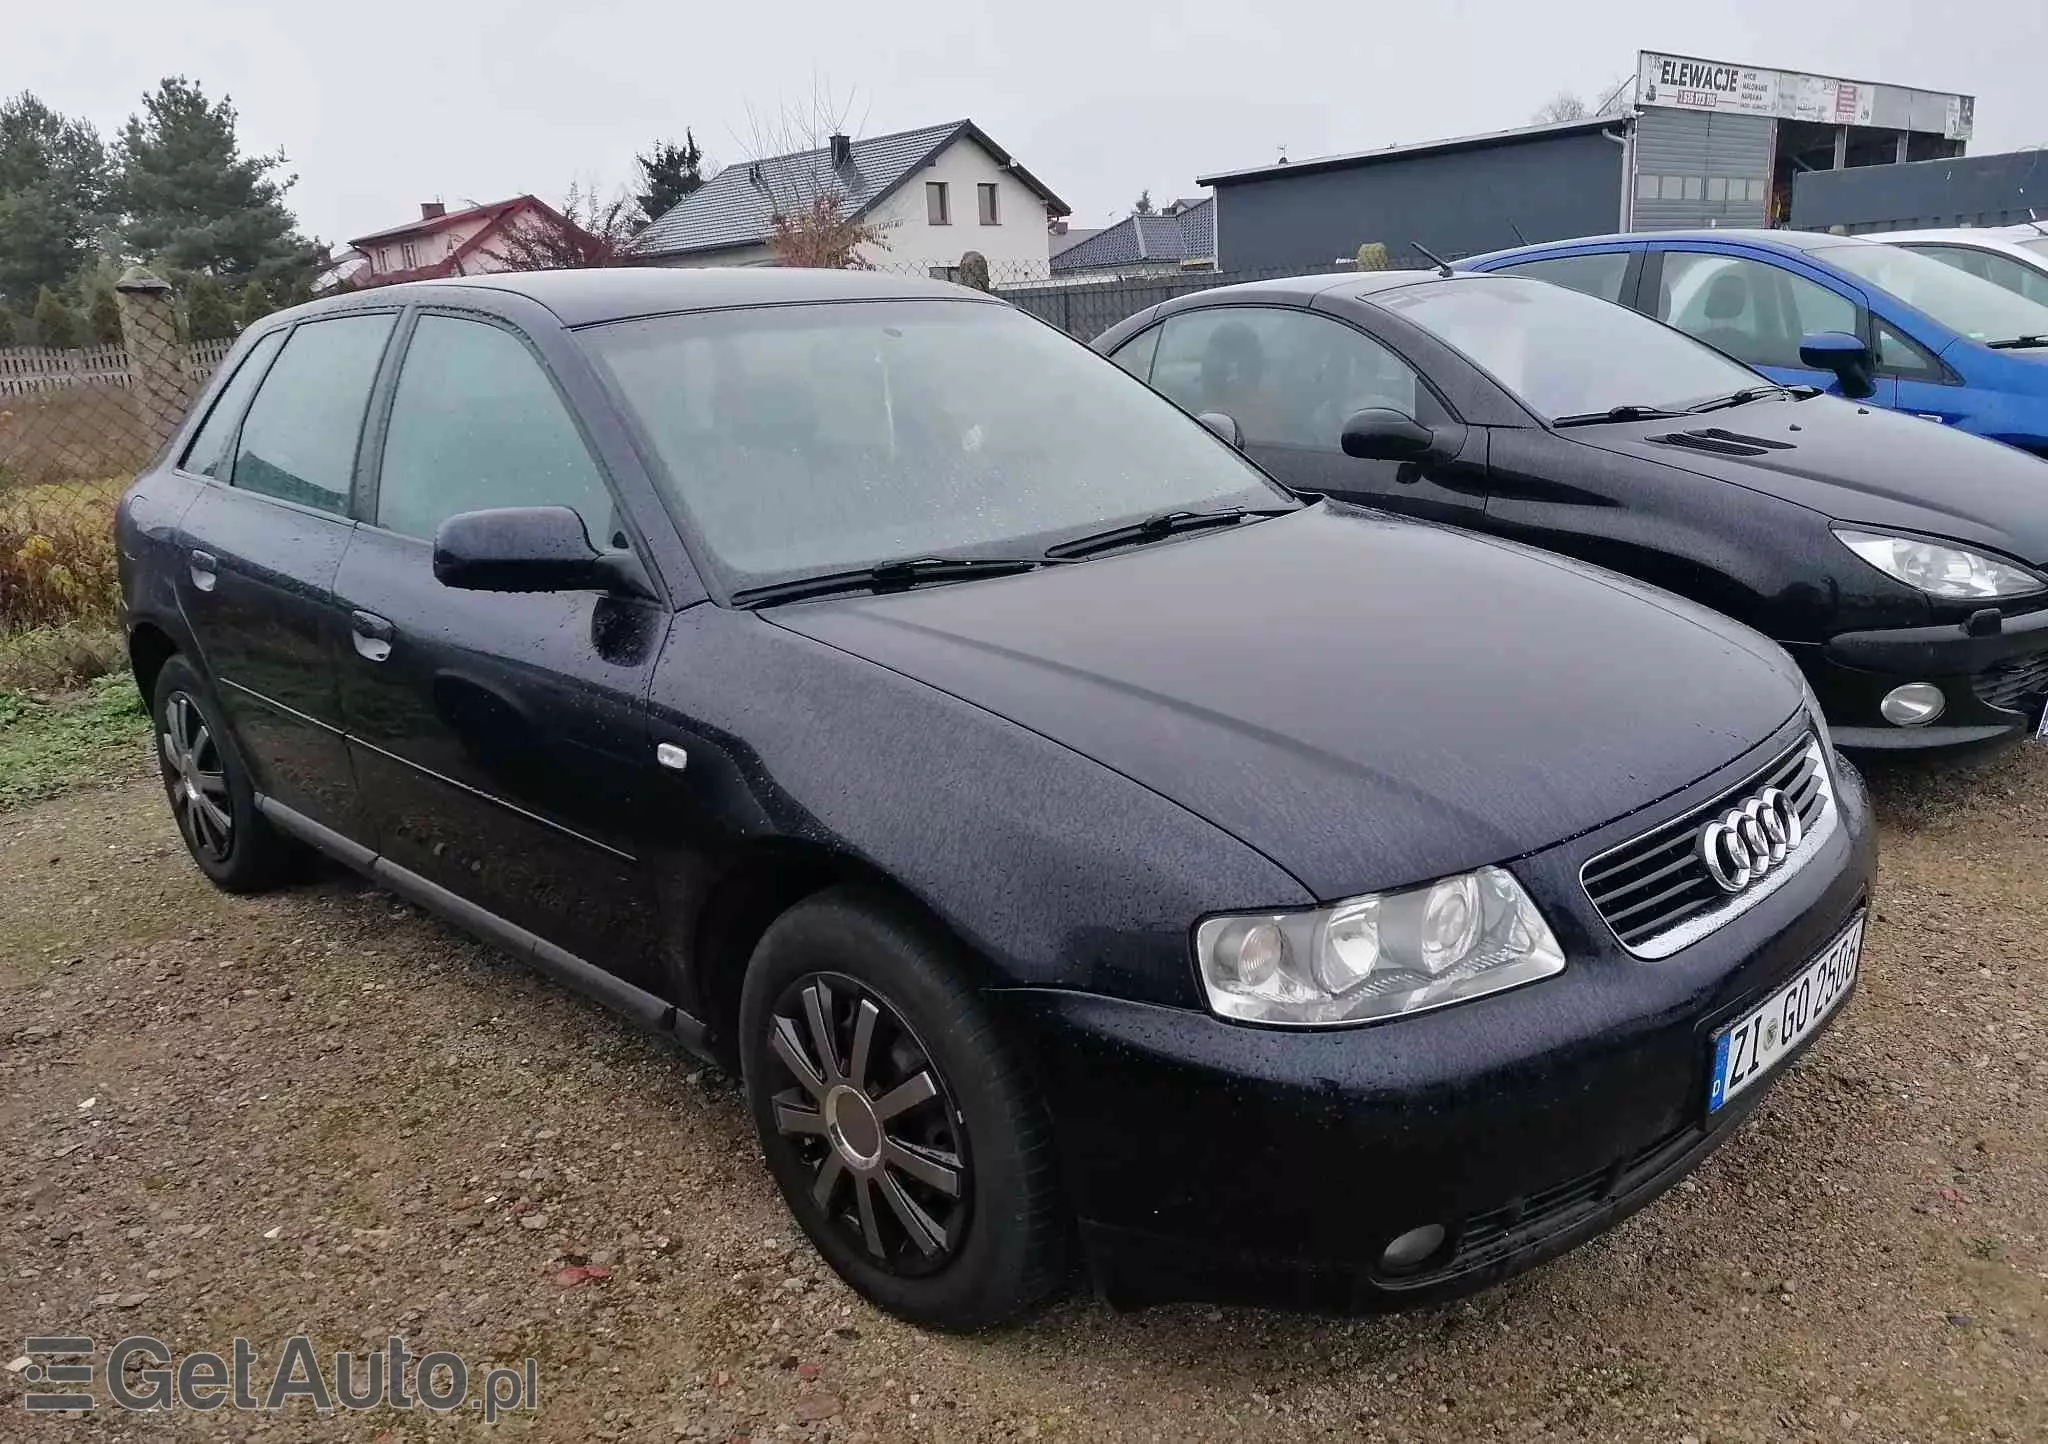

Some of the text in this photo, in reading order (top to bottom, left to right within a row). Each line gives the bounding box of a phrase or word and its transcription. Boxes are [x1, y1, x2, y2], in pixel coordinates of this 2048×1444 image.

[1660, 61, 1739, 92] ELEWACJE
[1729, 927, 1857, 1089] ZI GO 2506
[1712, 1079, 1720, 1097] D
